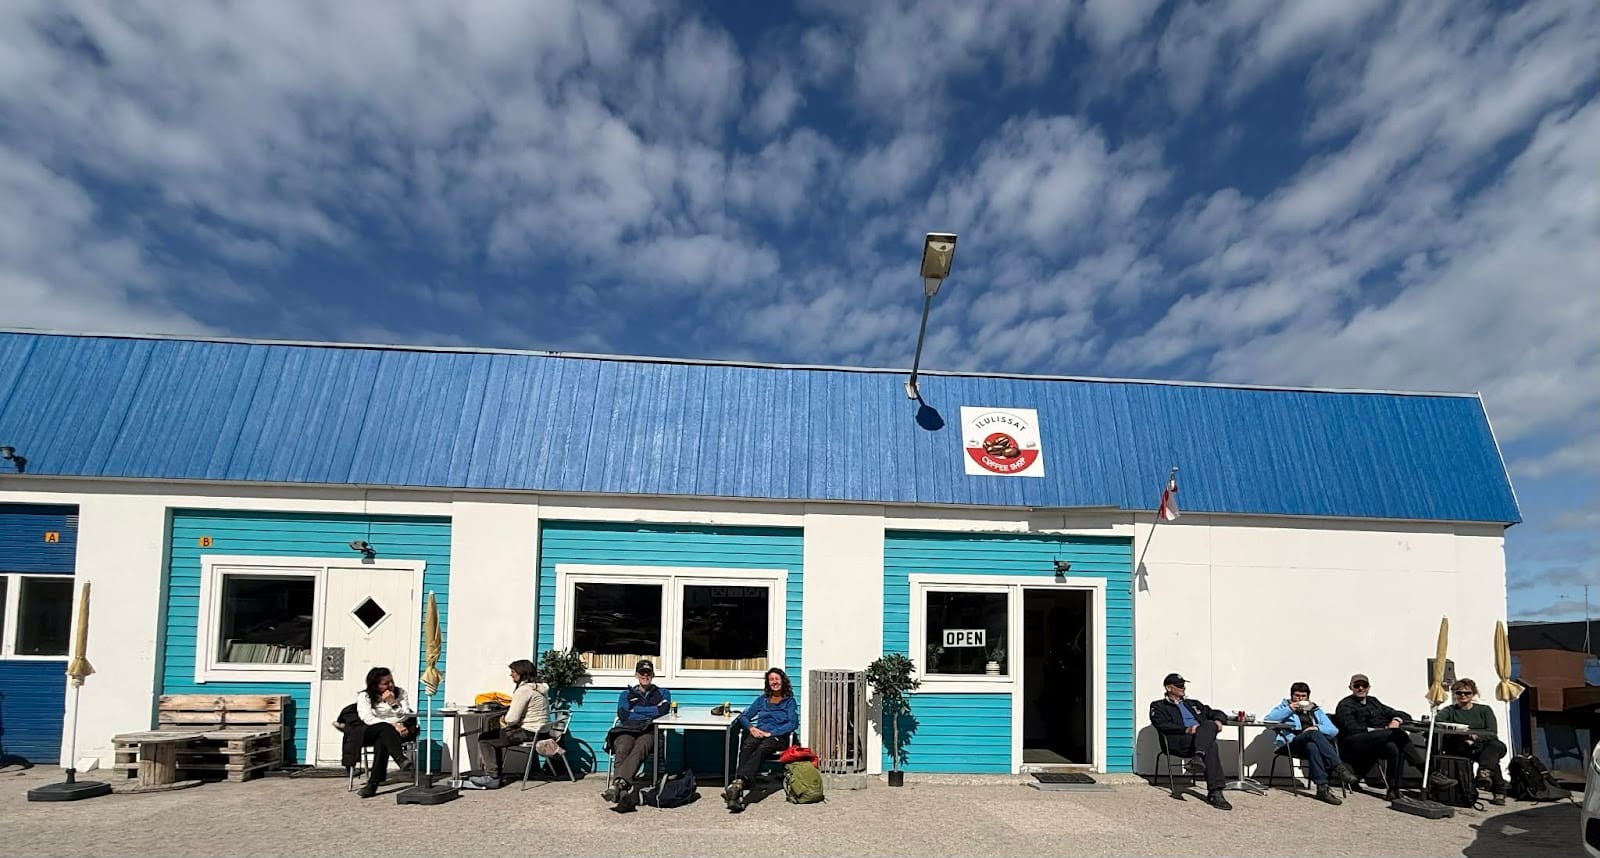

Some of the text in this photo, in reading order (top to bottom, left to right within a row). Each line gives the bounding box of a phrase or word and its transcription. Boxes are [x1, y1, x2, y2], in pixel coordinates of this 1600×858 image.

[975, 416, 1027, 432] ILULISSAT
[981, 456, 1026, 471] COFFEE SHOP
[49, 533, 56, 542] A
[203, 538, 210, 546] B
[946, 631, 983, 645] OPEN
